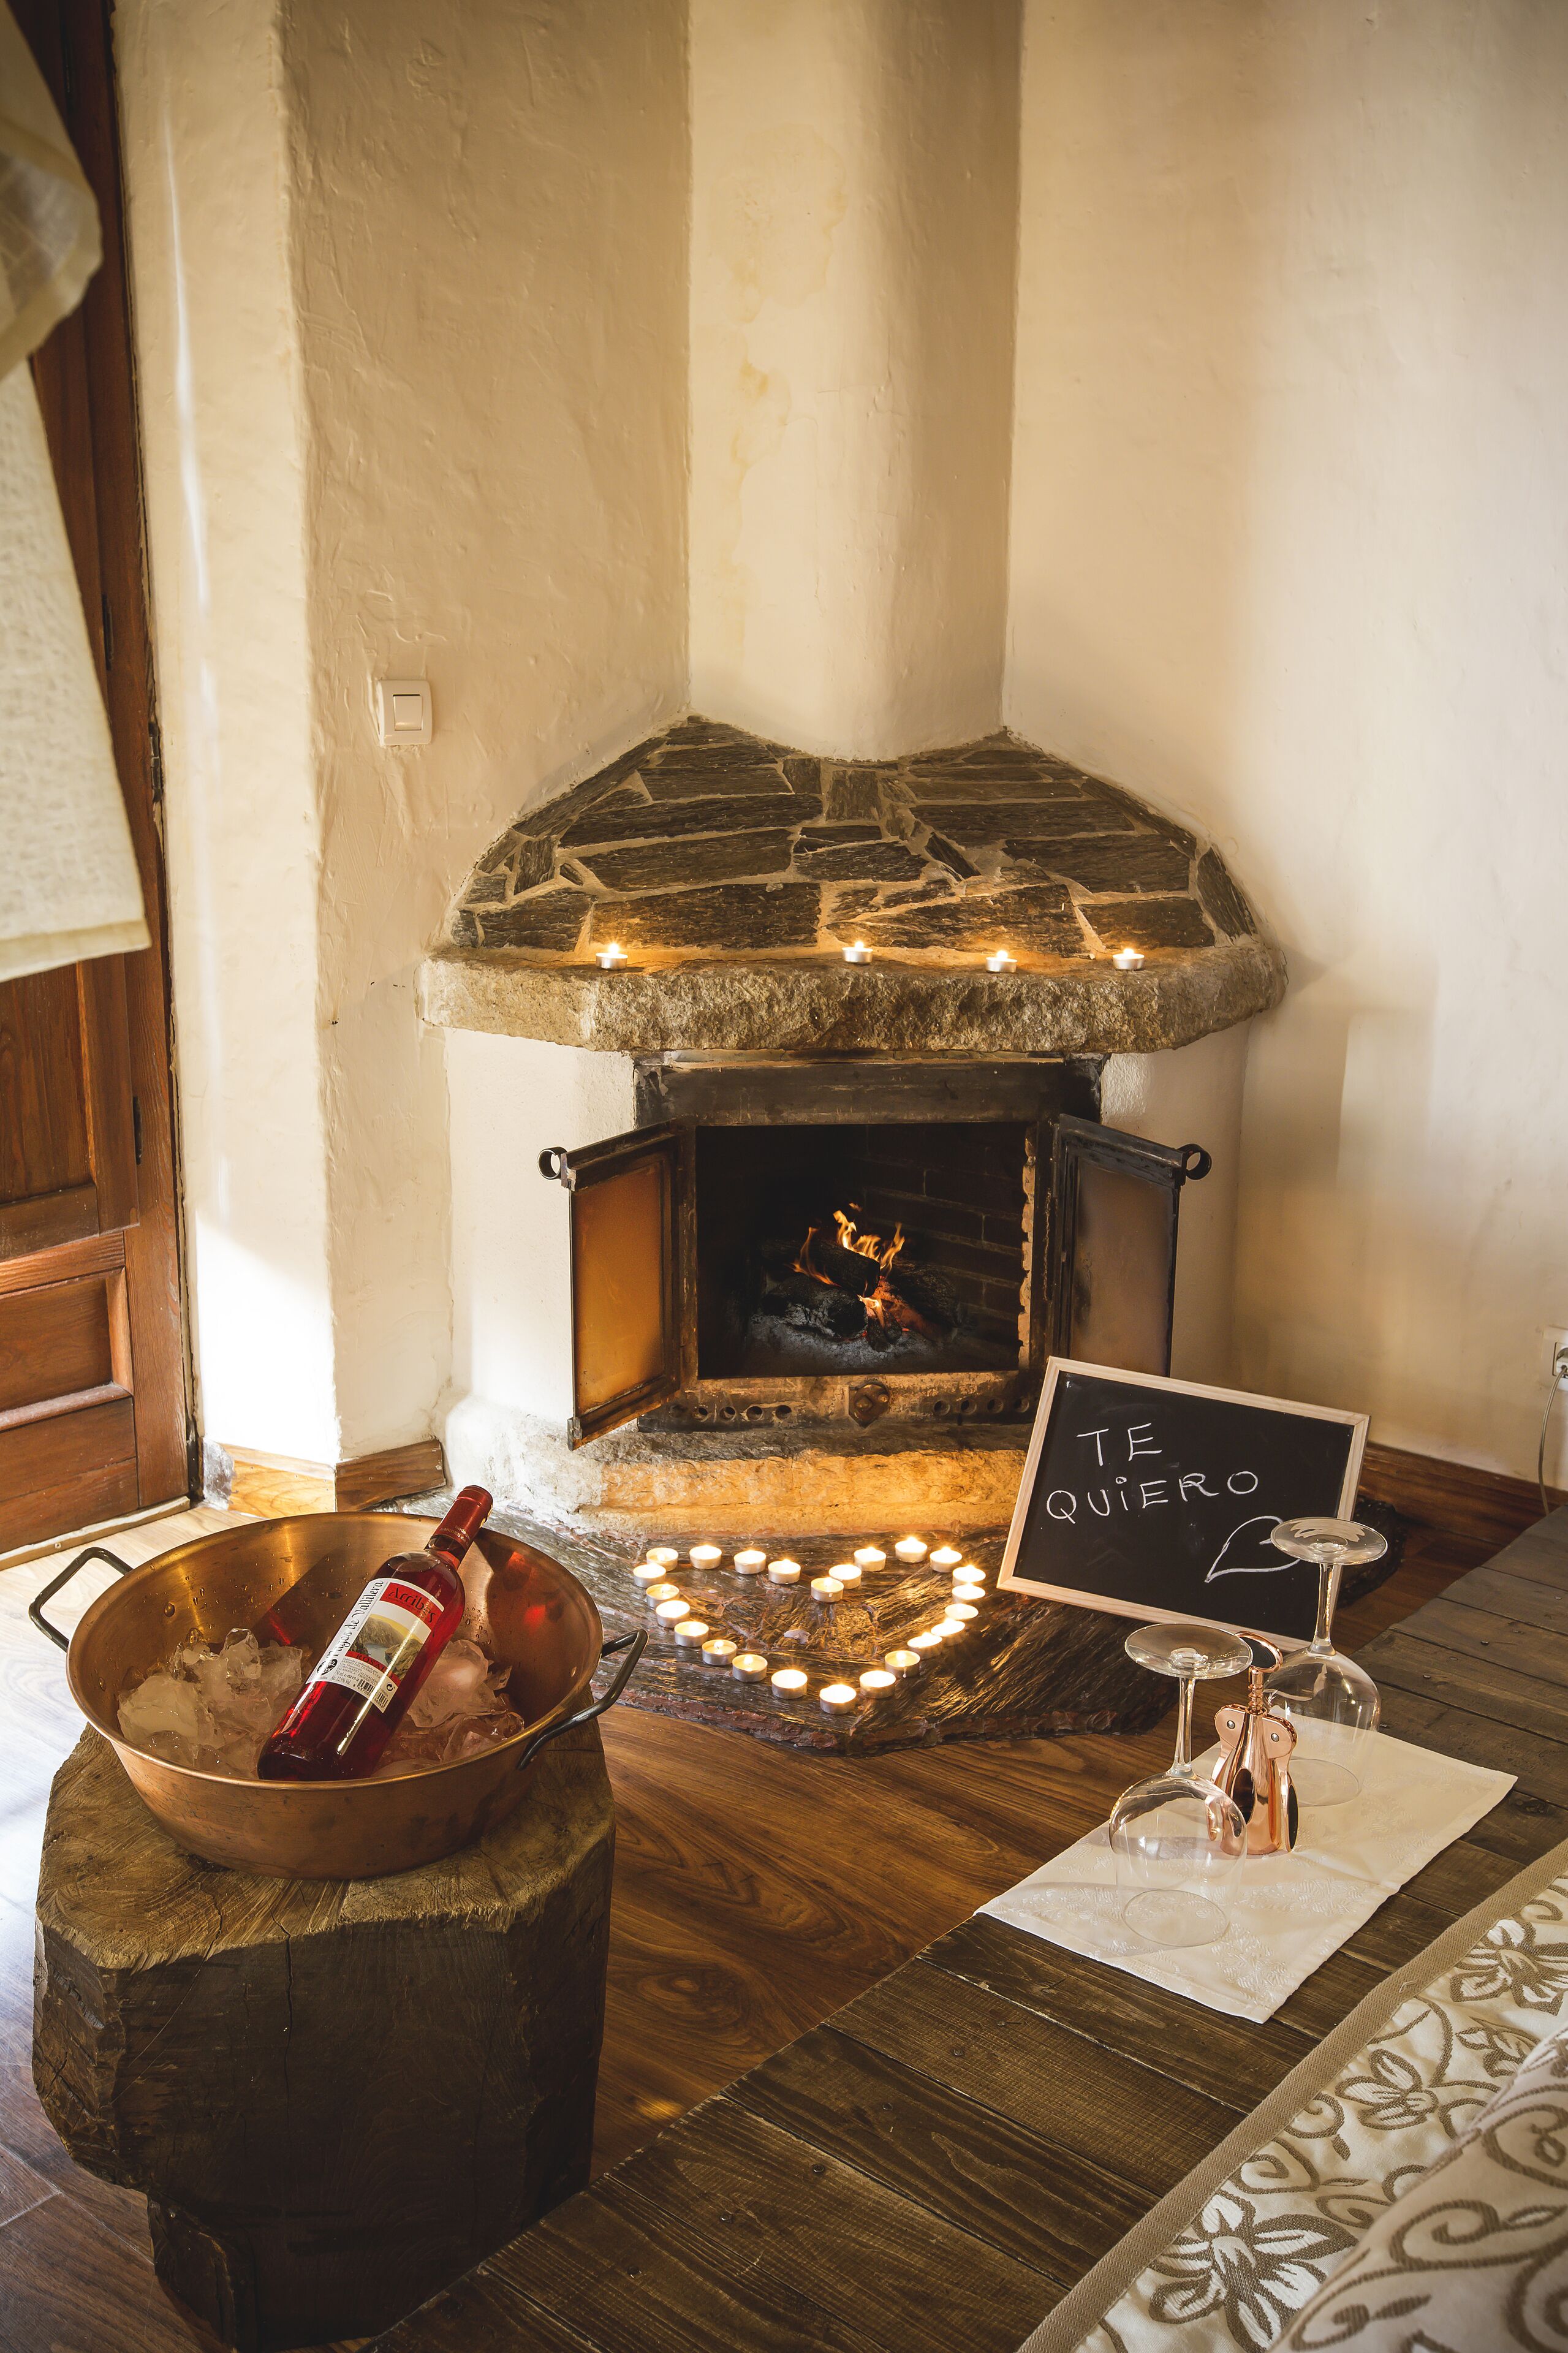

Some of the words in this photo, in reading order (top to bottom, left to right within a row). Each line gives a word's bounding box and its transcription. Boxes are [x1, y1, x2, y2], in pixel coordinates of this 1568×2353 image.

[1077, 1423, 1162, 1466] TE
[351, 1580, 384, 1619] Vallilera
[388, 1587, 437, 1623] Arribes
[347, 1619, 360, 1630] de
